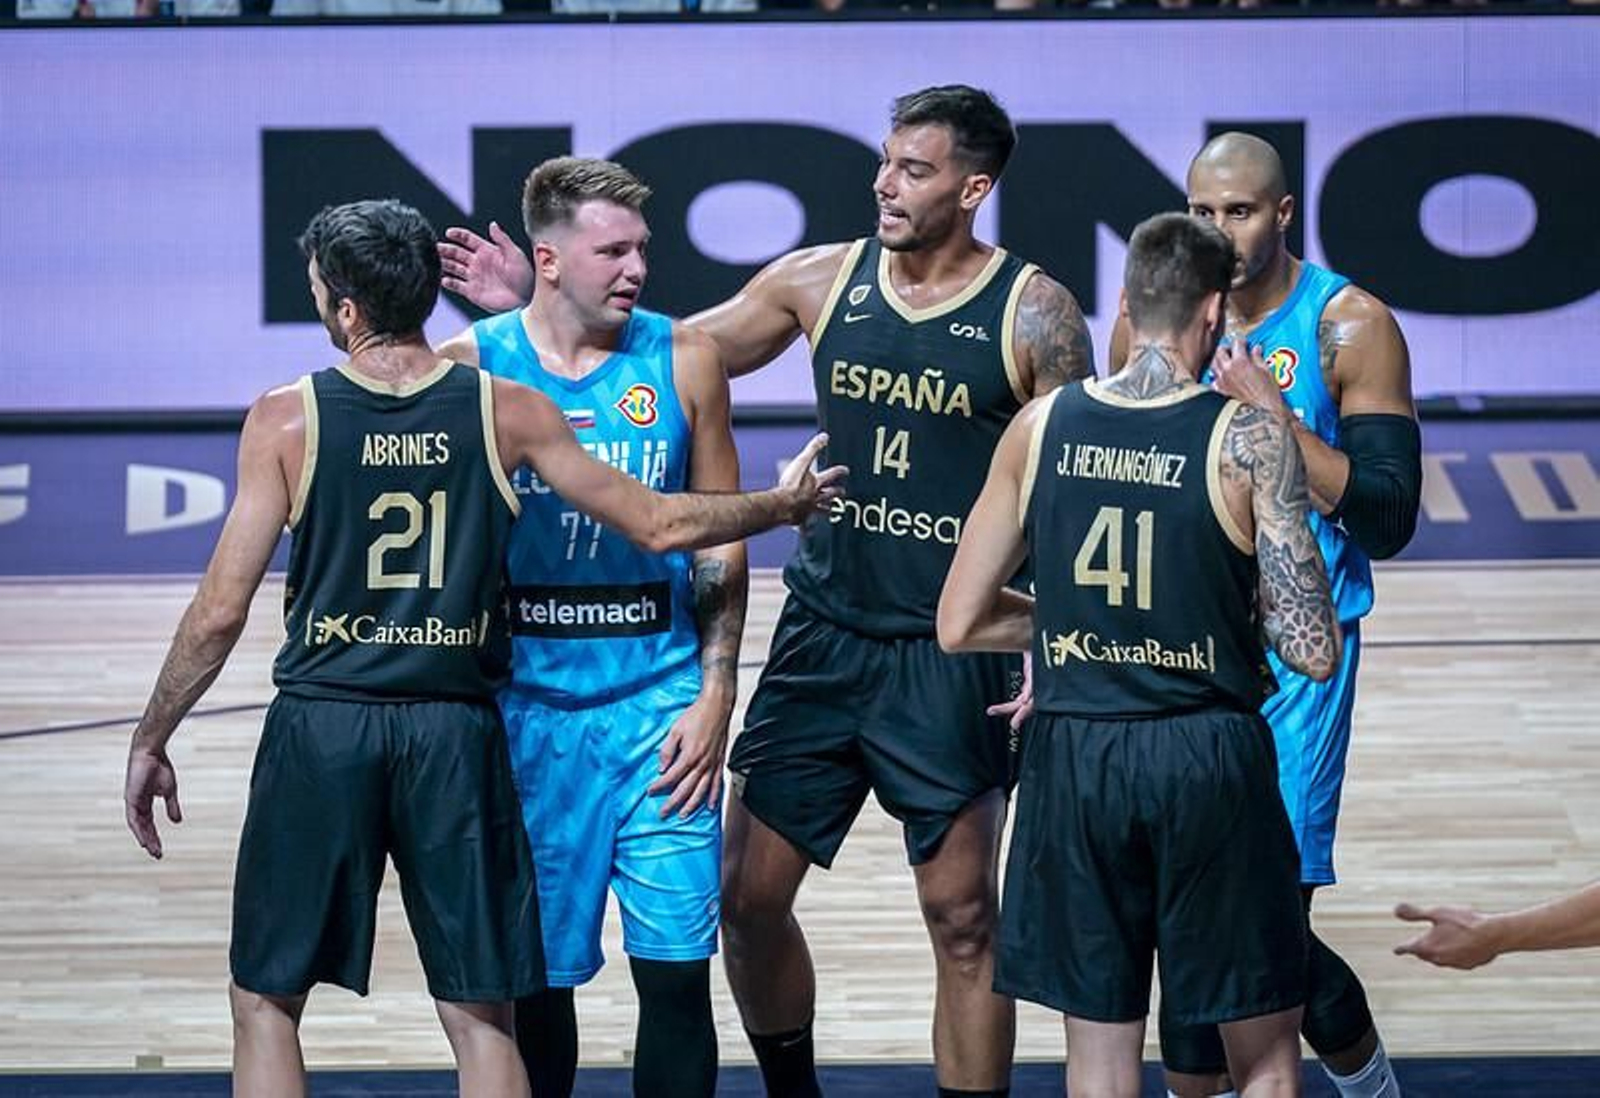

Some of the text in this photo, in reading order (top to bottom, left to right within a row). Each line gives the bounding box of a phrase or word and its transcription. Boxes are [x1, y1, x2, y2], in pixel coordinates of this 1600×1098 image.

[830, 360, 973, 417] ESPAÑA
[361, 432, 450, 467] ABRINES
[872, 426, 911, 479] 14
[366, 490, 447, 591] 21
[560, 511, 602, 561] 77
[829, 497, 961, 544] endesa
[1073, 506, 1155, 612] 41
[519, 596, 657, 625] telemach
[1083, 632, 1208, 671] CaixaBank
